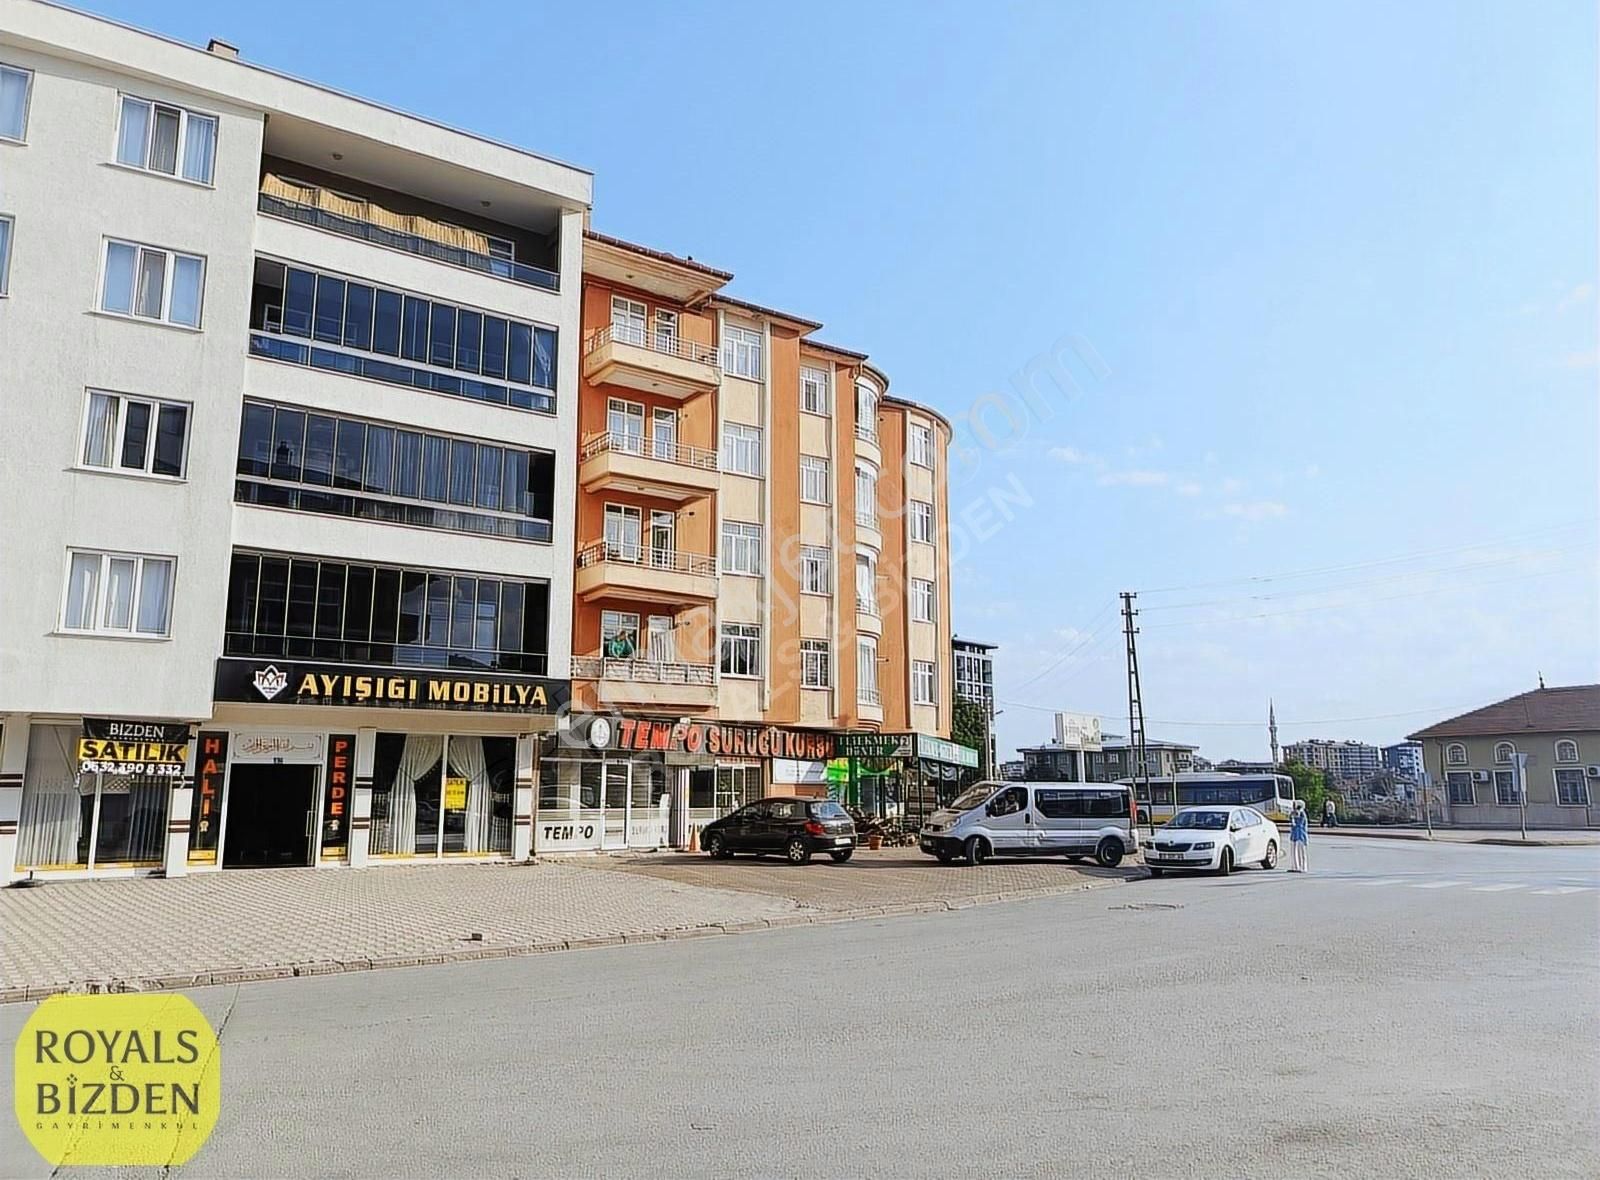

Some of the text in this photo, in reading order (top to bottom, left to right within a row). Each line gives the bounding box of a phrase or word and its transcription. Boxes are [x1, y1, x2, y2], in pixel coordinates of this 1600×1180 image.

[298, 673, 417, 701] AYIŞIĞI
[82, 740, 184, 761] SATILIK
[619, 718, 702, 752] TEMPO
[785, 732, 835, 760] KURSU
[331, 741, 348, 814] PERDE
